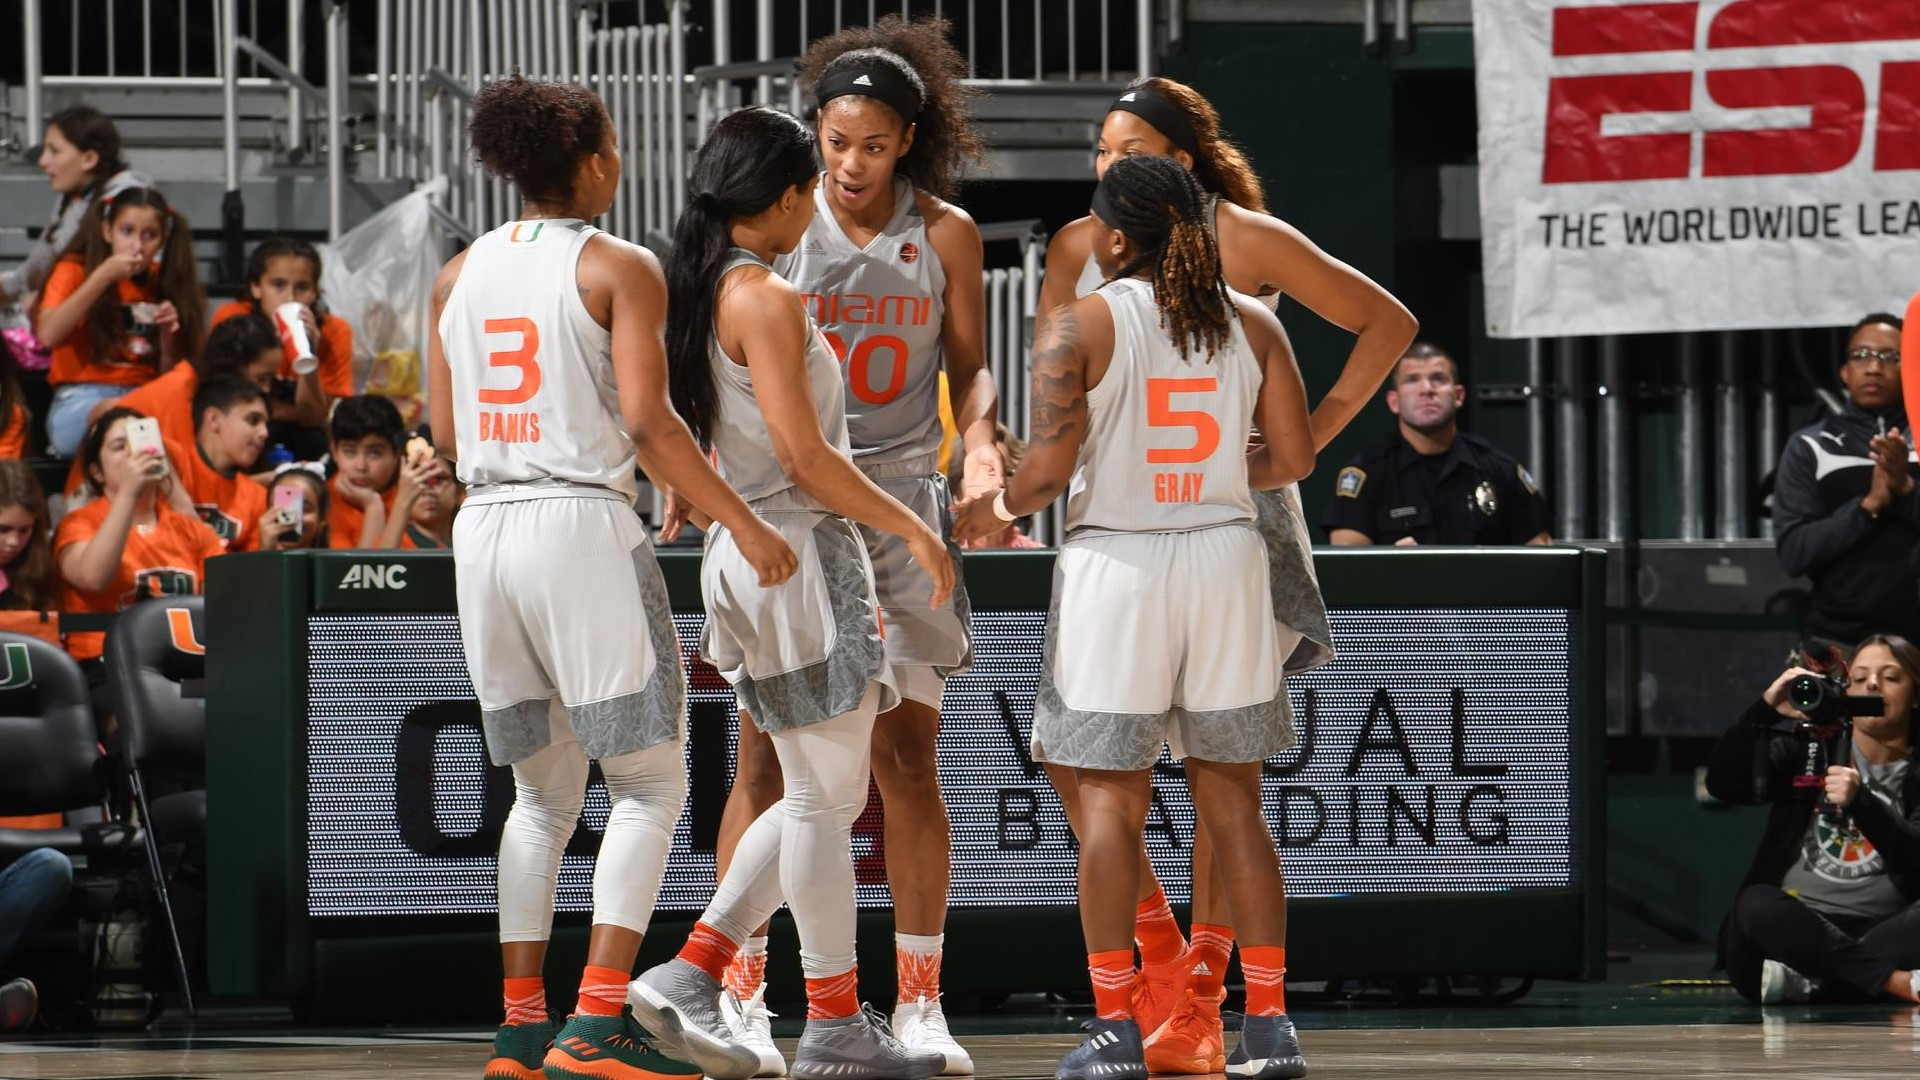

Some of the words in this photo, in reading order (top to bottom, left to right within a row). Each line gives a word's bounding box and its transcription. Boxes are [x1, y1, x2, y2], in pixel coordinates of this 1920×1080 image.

[510, 222, 545, 243] U
[1538, 212, 1608, 248] THE
[1623, 203, 1842, 246] WORLDWIDE
[478, 317, 542, 405] 3
[479, 411, 541, 443] BANKS
[1146, 377, 1220, 464] 5
[1154, 472, 1204, 503] GRAY
[338, 563, 408, 590] ANC
